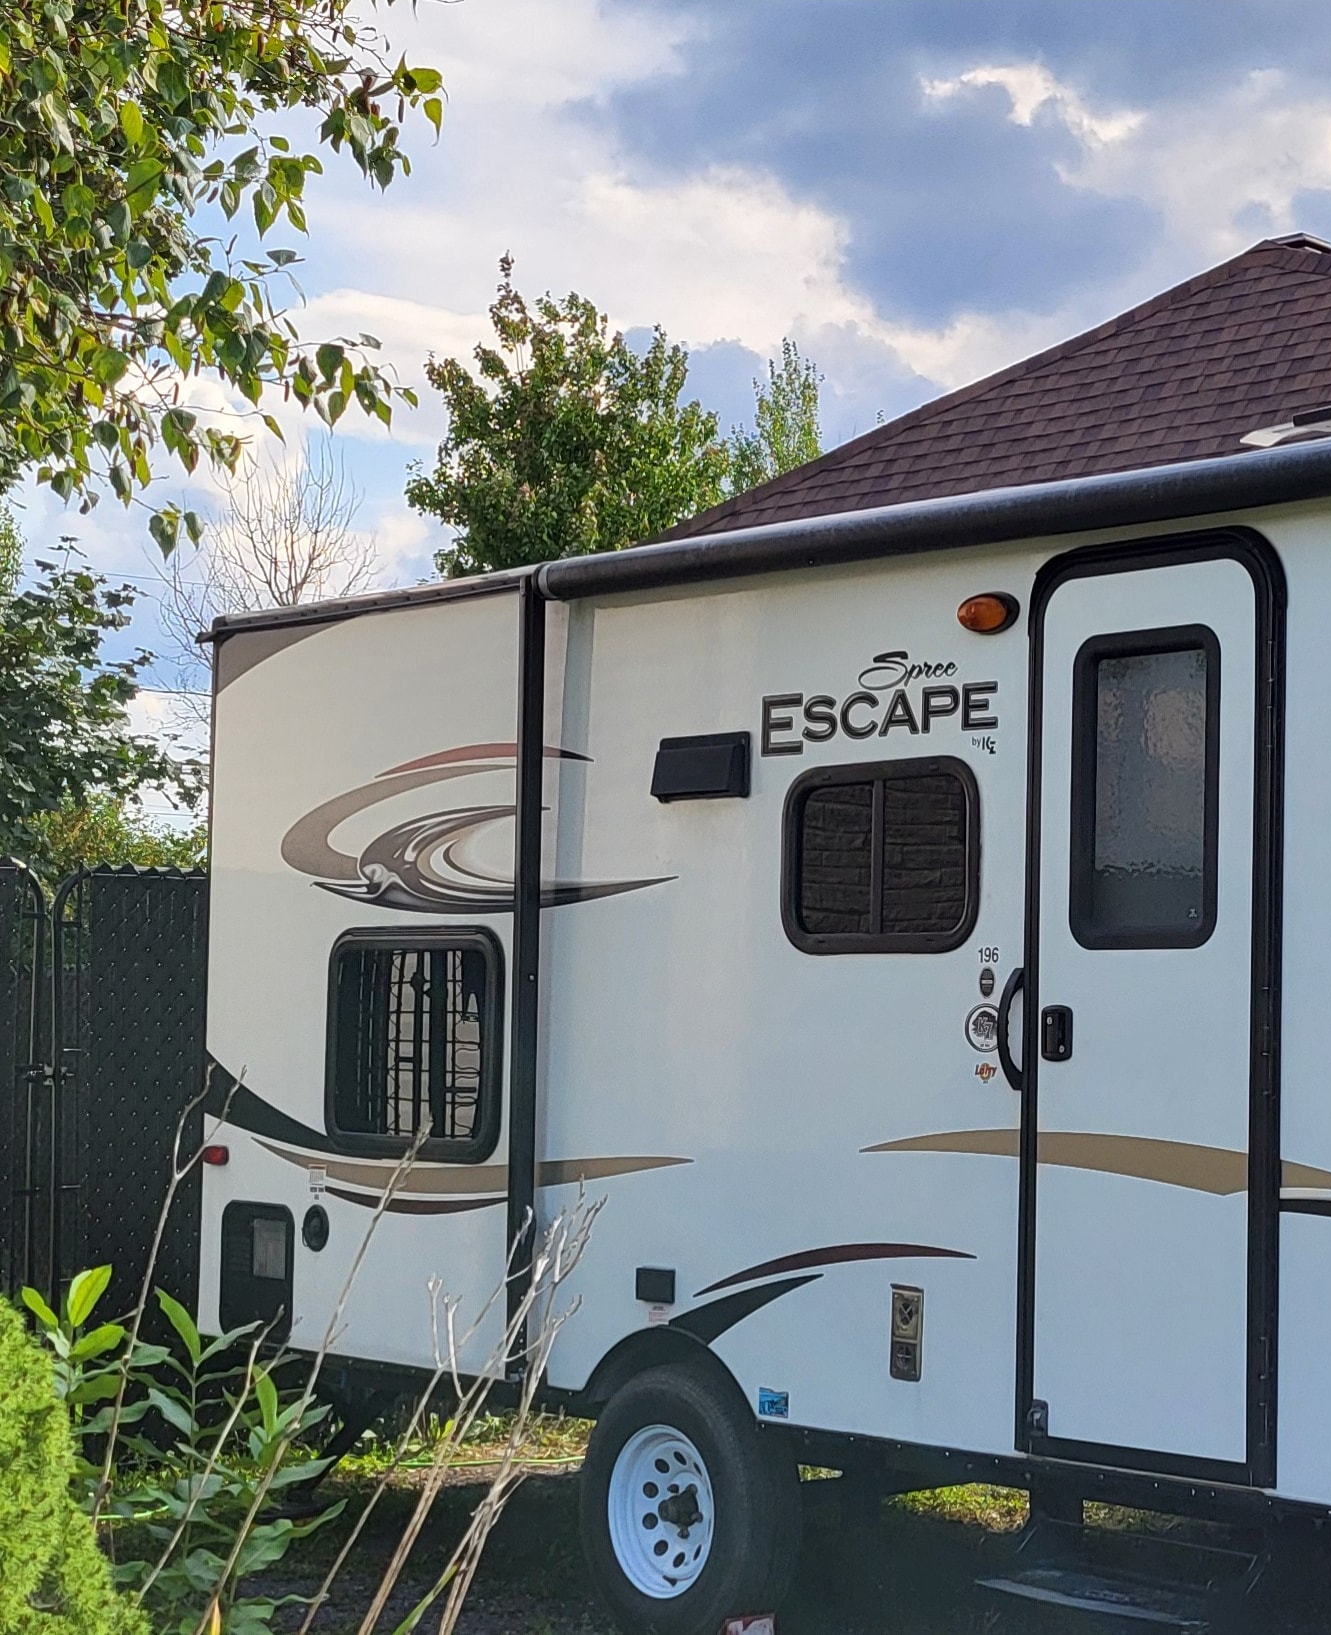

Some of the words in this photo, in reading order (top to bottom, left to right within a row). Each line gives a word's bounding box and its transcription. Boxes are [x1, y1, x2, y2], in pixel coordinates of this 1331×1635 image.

[858, 650, 958, 690] Spree
[761, 680, 999, 757] ESCAPE
[978, 947, 999, 963] 196
